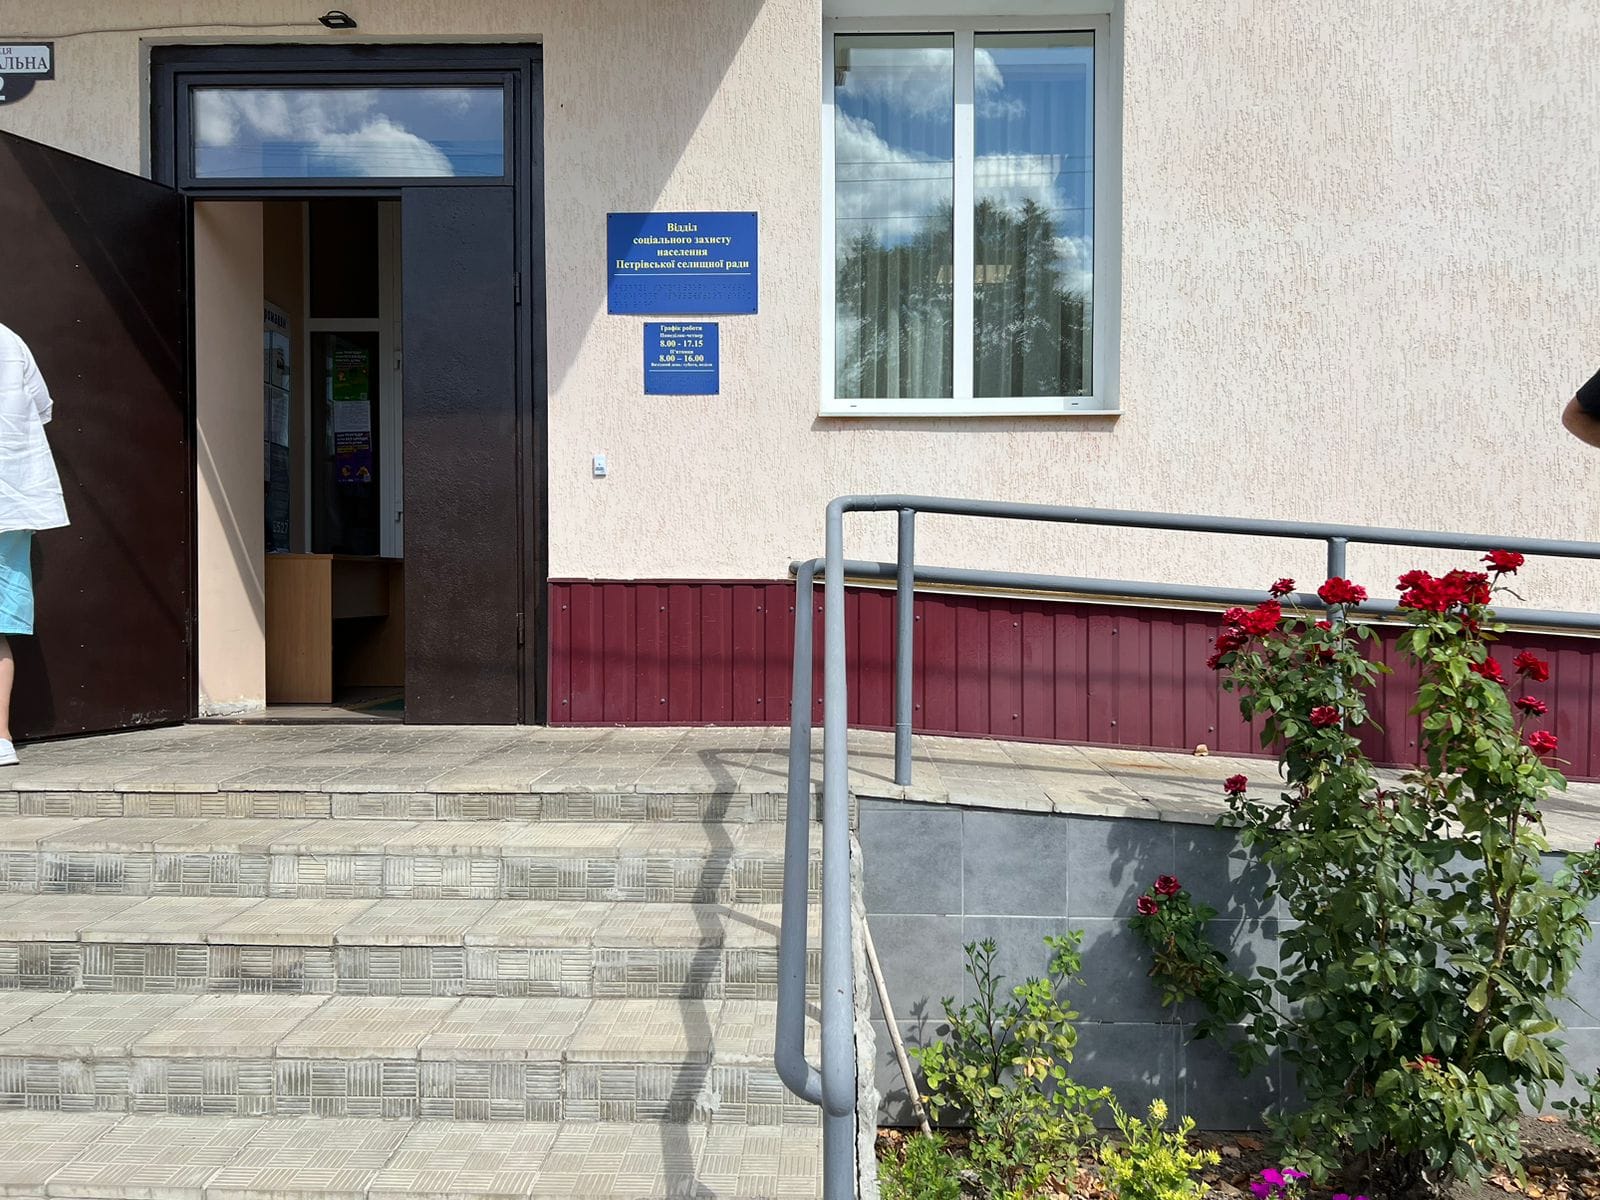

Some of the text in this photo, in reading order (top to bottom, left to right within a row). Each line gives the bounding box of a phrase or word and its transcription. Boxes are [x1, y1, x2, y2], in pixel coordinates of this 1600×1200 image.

[667, 222, 698, 233] Відділ
[633, 235, 732, 246] соціального захисту
[657, 248, 708, 257] населення
[616, 259, 750, 271] Петрівської селищної ради
